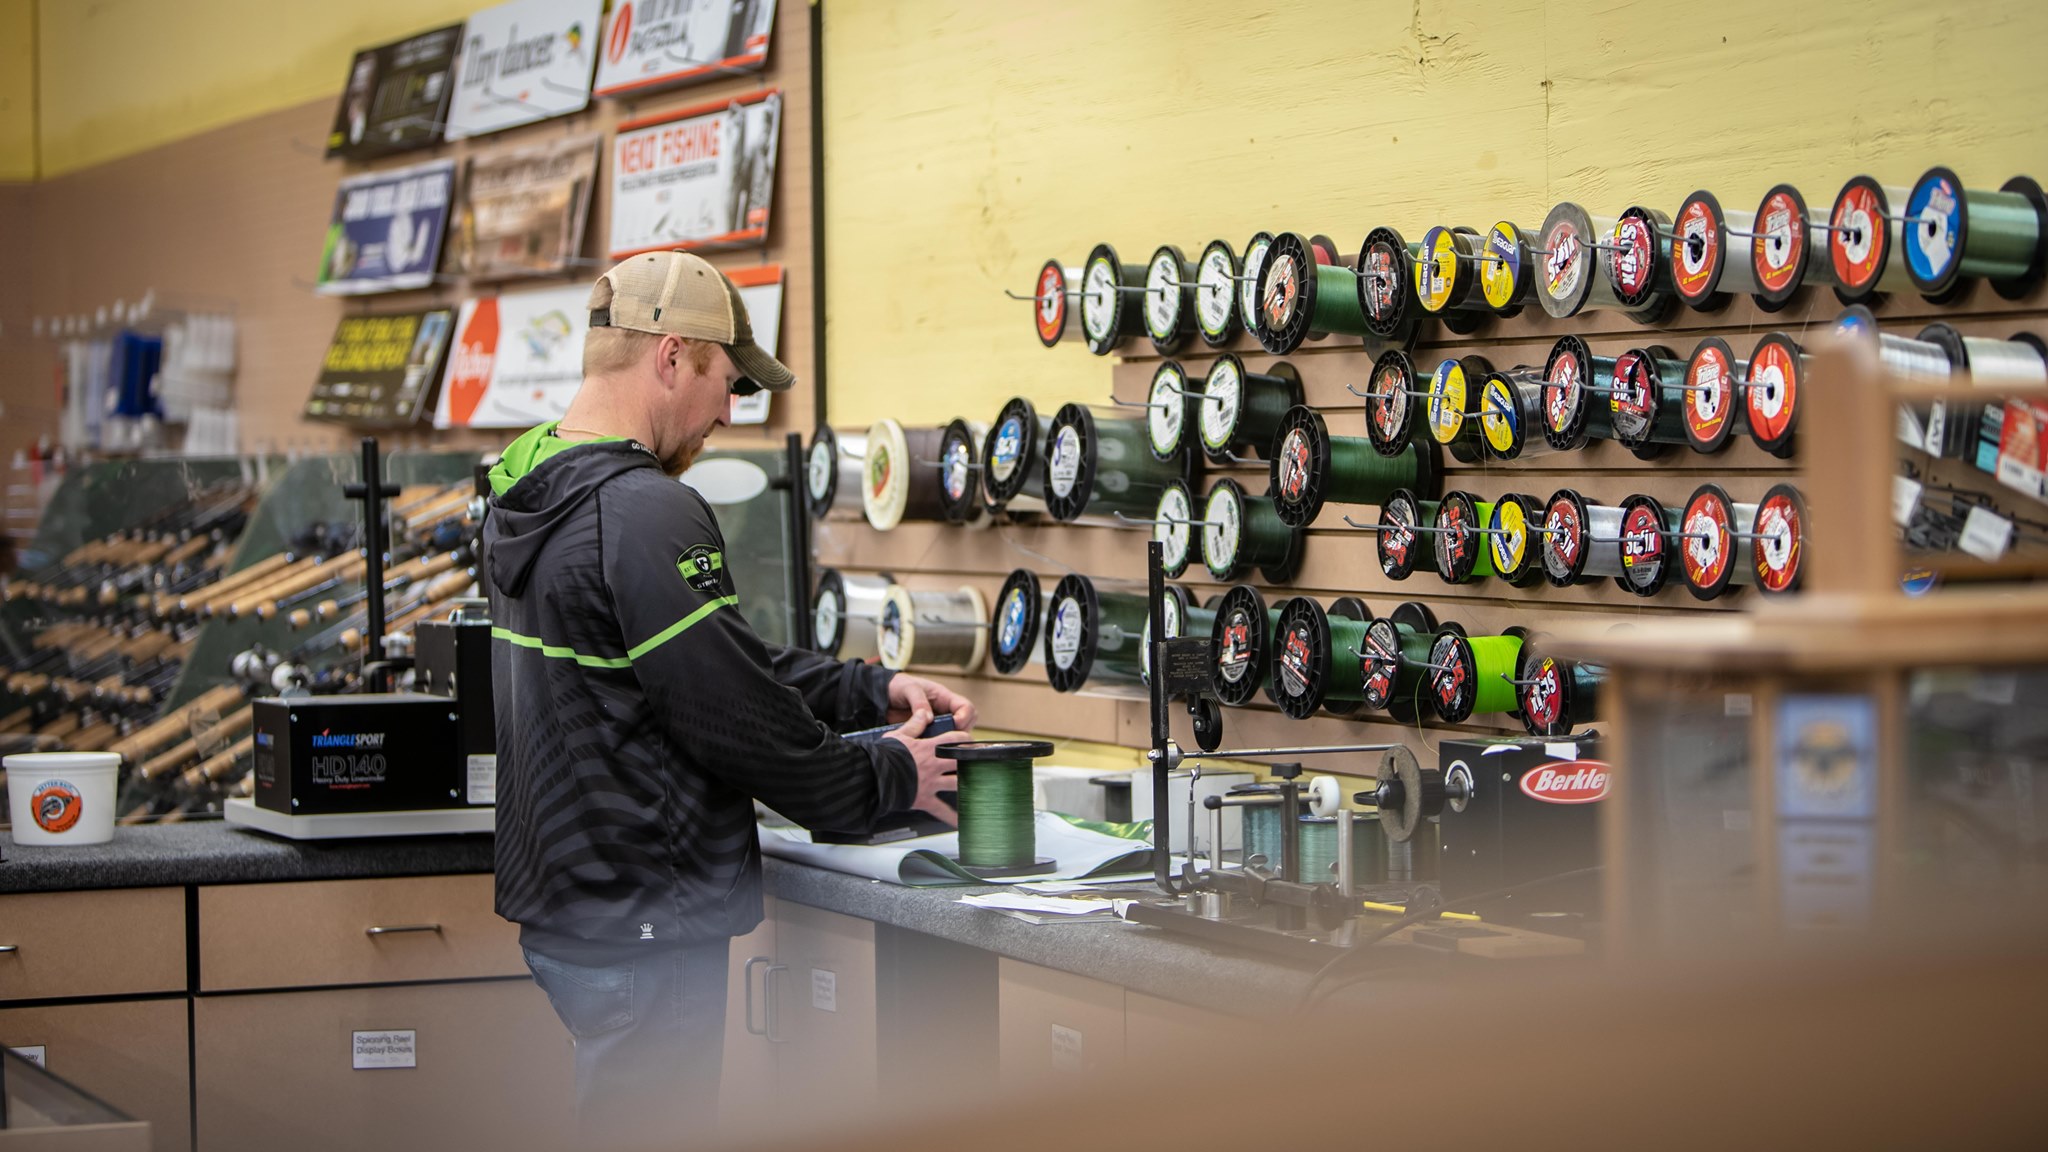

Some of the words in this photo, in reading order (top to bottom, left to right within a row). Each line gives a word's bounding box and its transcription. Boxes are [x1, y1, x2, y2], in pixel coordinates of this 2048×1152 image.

[1492, 230, 1517, 255] Seaguar
[1490, 385, 1512, 412] Seaguar
[1613, 376, 1646, 407] Suix
[356, 1034, 391, 1046] Spinning
[393, 1034, 411, 1043] Reel
[357, 1046, 385, 1056] Display
